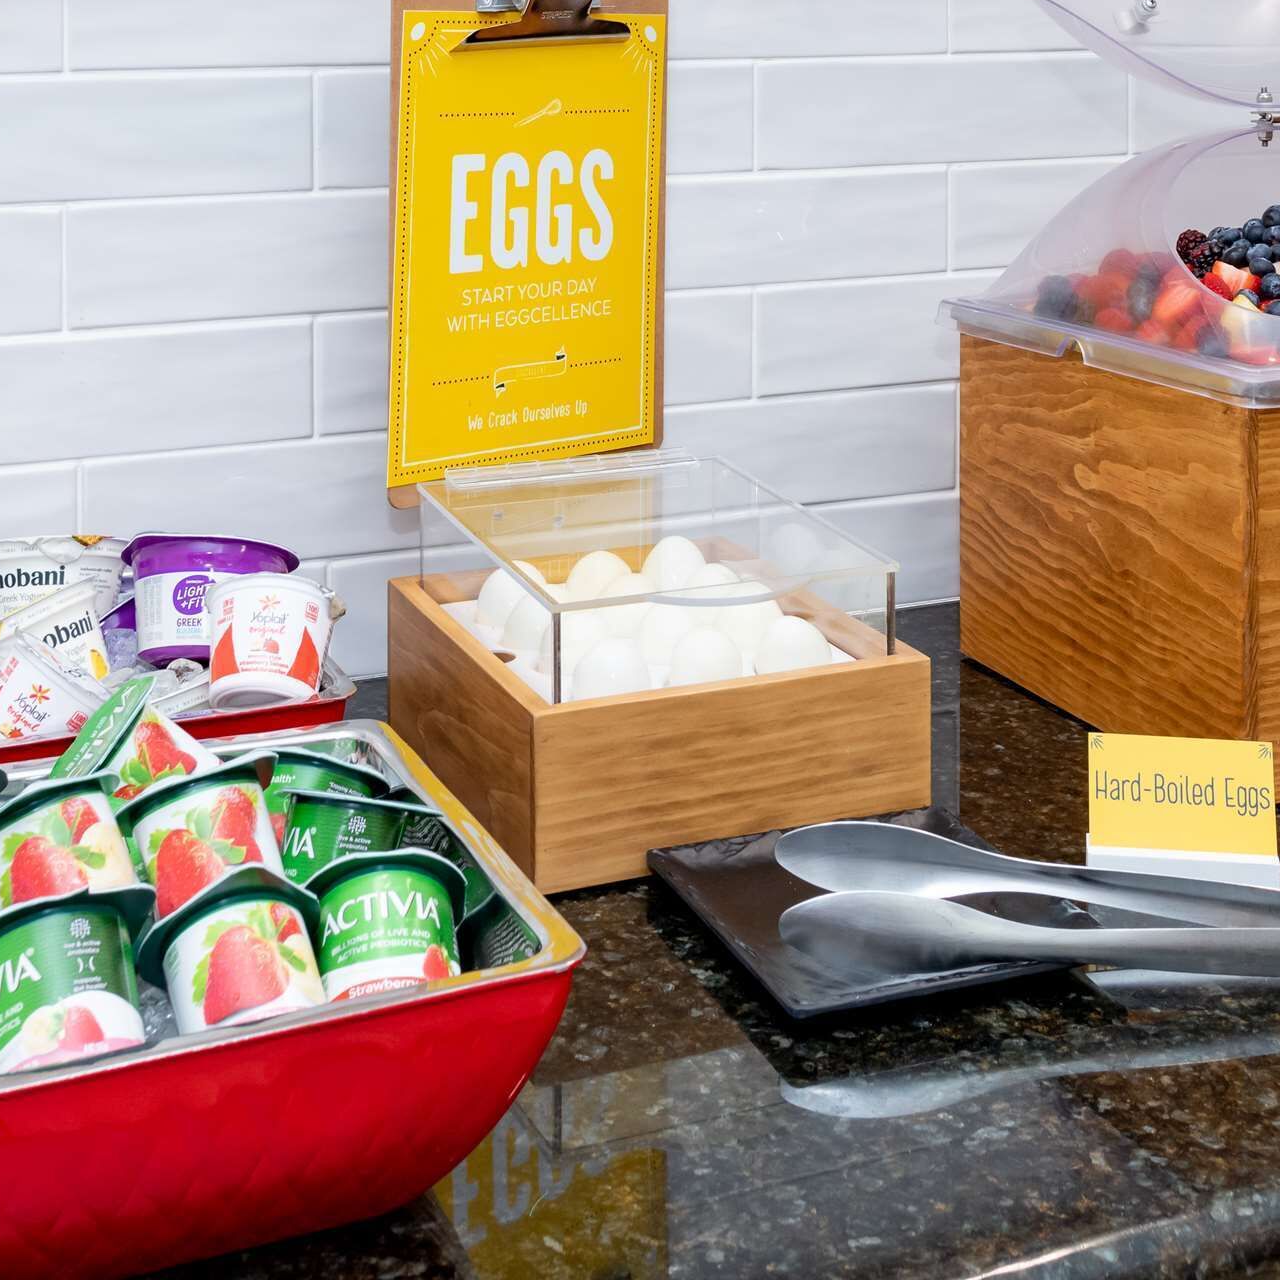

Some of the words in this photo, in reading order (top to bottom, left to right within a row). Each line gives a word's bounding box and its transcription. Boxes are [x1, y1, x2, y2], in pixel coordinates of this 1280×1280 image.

[448, 147, 615, 275] EGGS
[461, 285, 514, 307] START
[518, 279, 563, 301] YOUR
[567, 276, 598, 296] DAY
[447, 312, 491, 334] WITH
[494, 299, 612, 329] EGGCELLENCE
[467, 415, 484, 433] We
[487, 409, 519, 429] Crack
[522, 404, 571, 425] Ourselves
[575, 400, 589, 418] Up
[42, 609, 94, 649] obani
[176, 617, 202, 628] GREEK
[250, 610, 288, 626] Yoplait
[1094, 769, 1216, 807] Hard-Boiled
[1224, 777, 1271, 817] Eggs
[322, 889, 441, 948] ACTIVIA
[411, 928, 431, 939] AND
